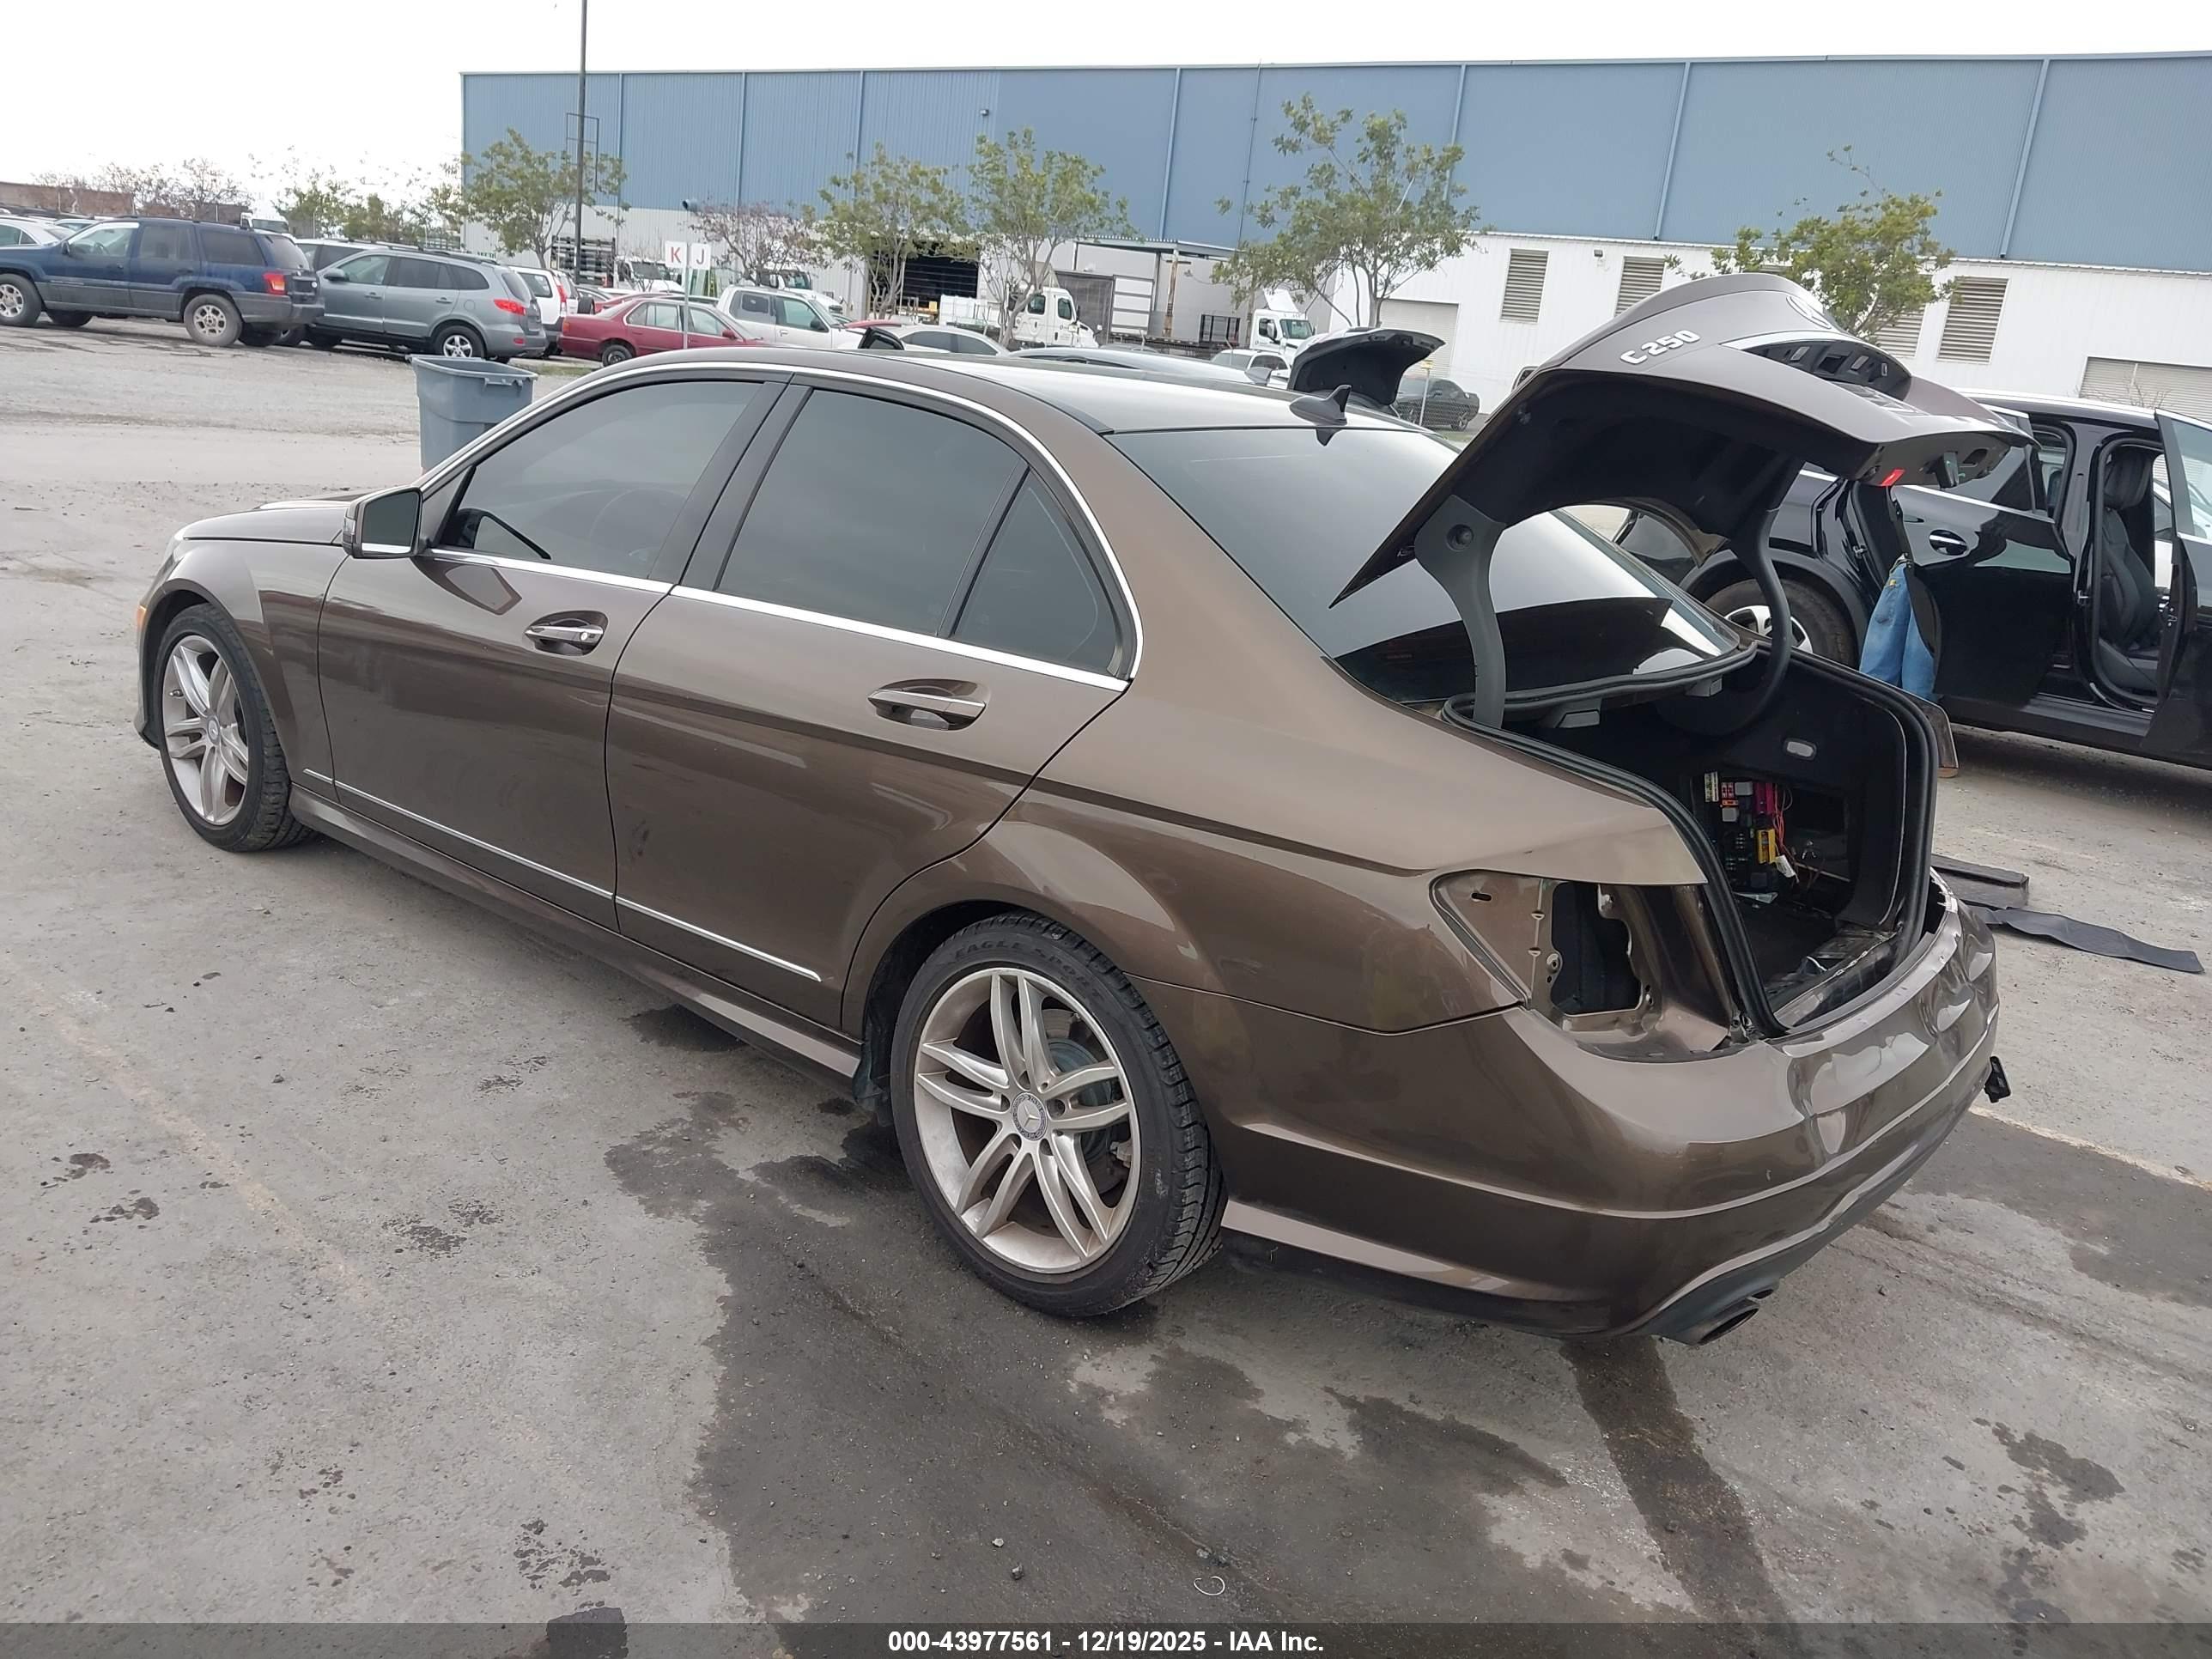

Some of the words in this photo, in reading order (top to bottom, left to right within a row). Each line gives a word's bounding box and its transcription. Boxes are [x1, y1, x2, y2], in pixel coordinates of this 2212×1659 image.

[671, 246, 681, 263] K
[696, 248, 705, 264] J
[1620, 349, 1647, 365] C
[1641, 330, 1701, 356] 250
